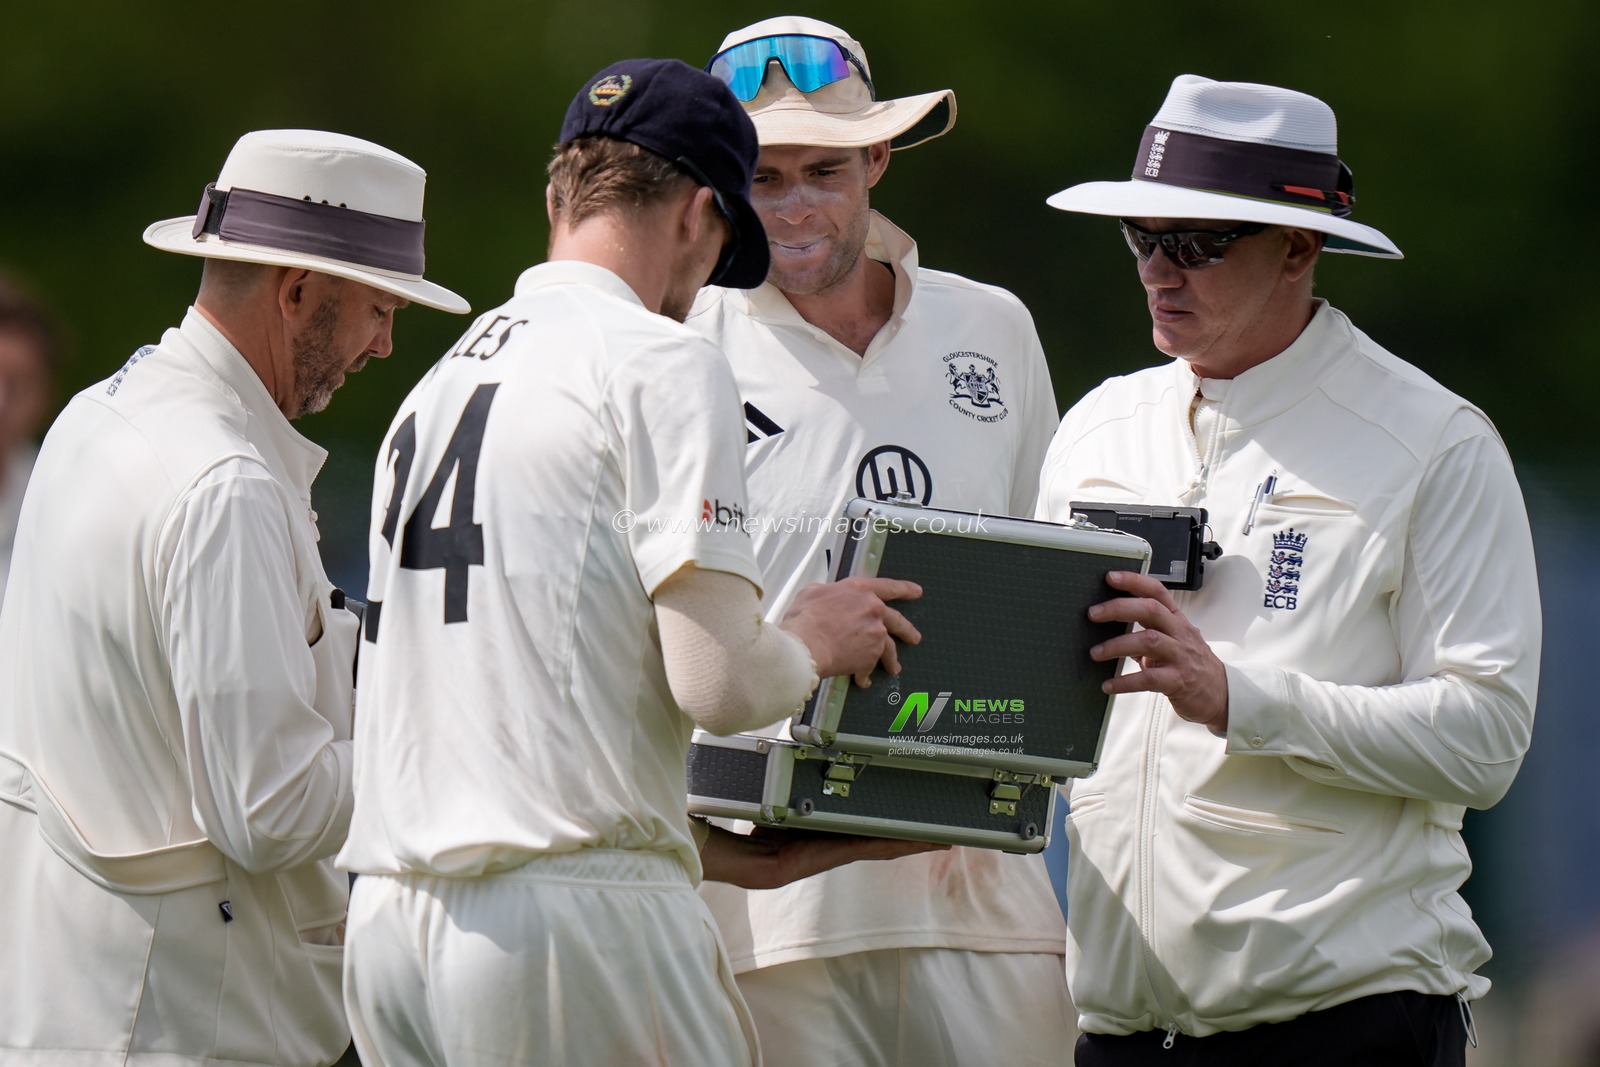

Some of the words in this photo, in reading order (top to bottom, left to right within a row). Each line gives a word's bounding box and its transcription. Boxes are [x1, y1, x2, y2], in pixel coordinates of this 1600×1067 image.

[1145, 166, 1159, 177] ECB
[942, 351, 998, 369] GLOUCESTERSHIRE
[949, 399, 975, 419] COUNTY
[976, 414, 998, 423] CRICKET
[1264, 594, 1297, 611] ECB
